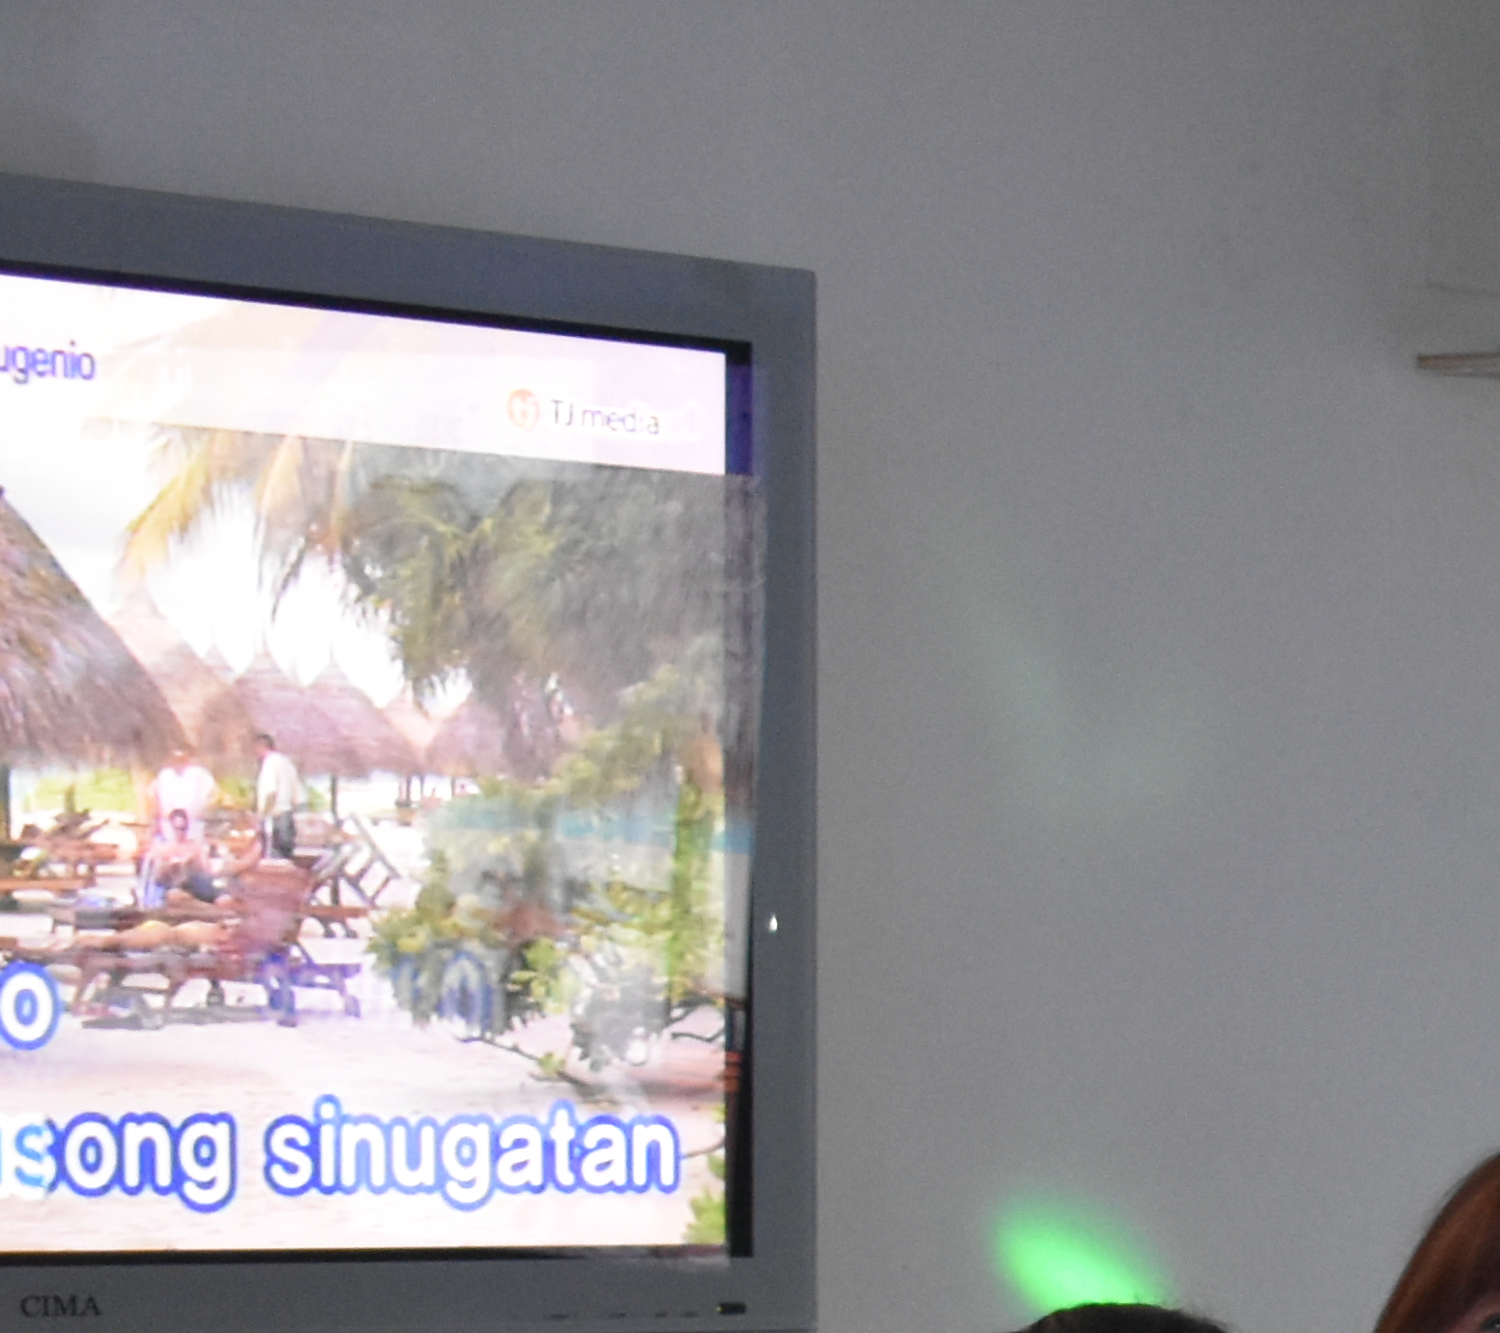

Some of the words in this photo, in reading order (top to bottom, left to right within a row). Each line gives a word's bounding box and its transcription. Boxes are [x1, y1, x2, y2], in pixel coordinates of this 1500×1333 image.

[581, 407, 661, 436] meda
[0, 1111, 236, 1213] song
[263, 1094, 681, 1212] sinugatan
[20, 1294, 102, 1319] CIMA
